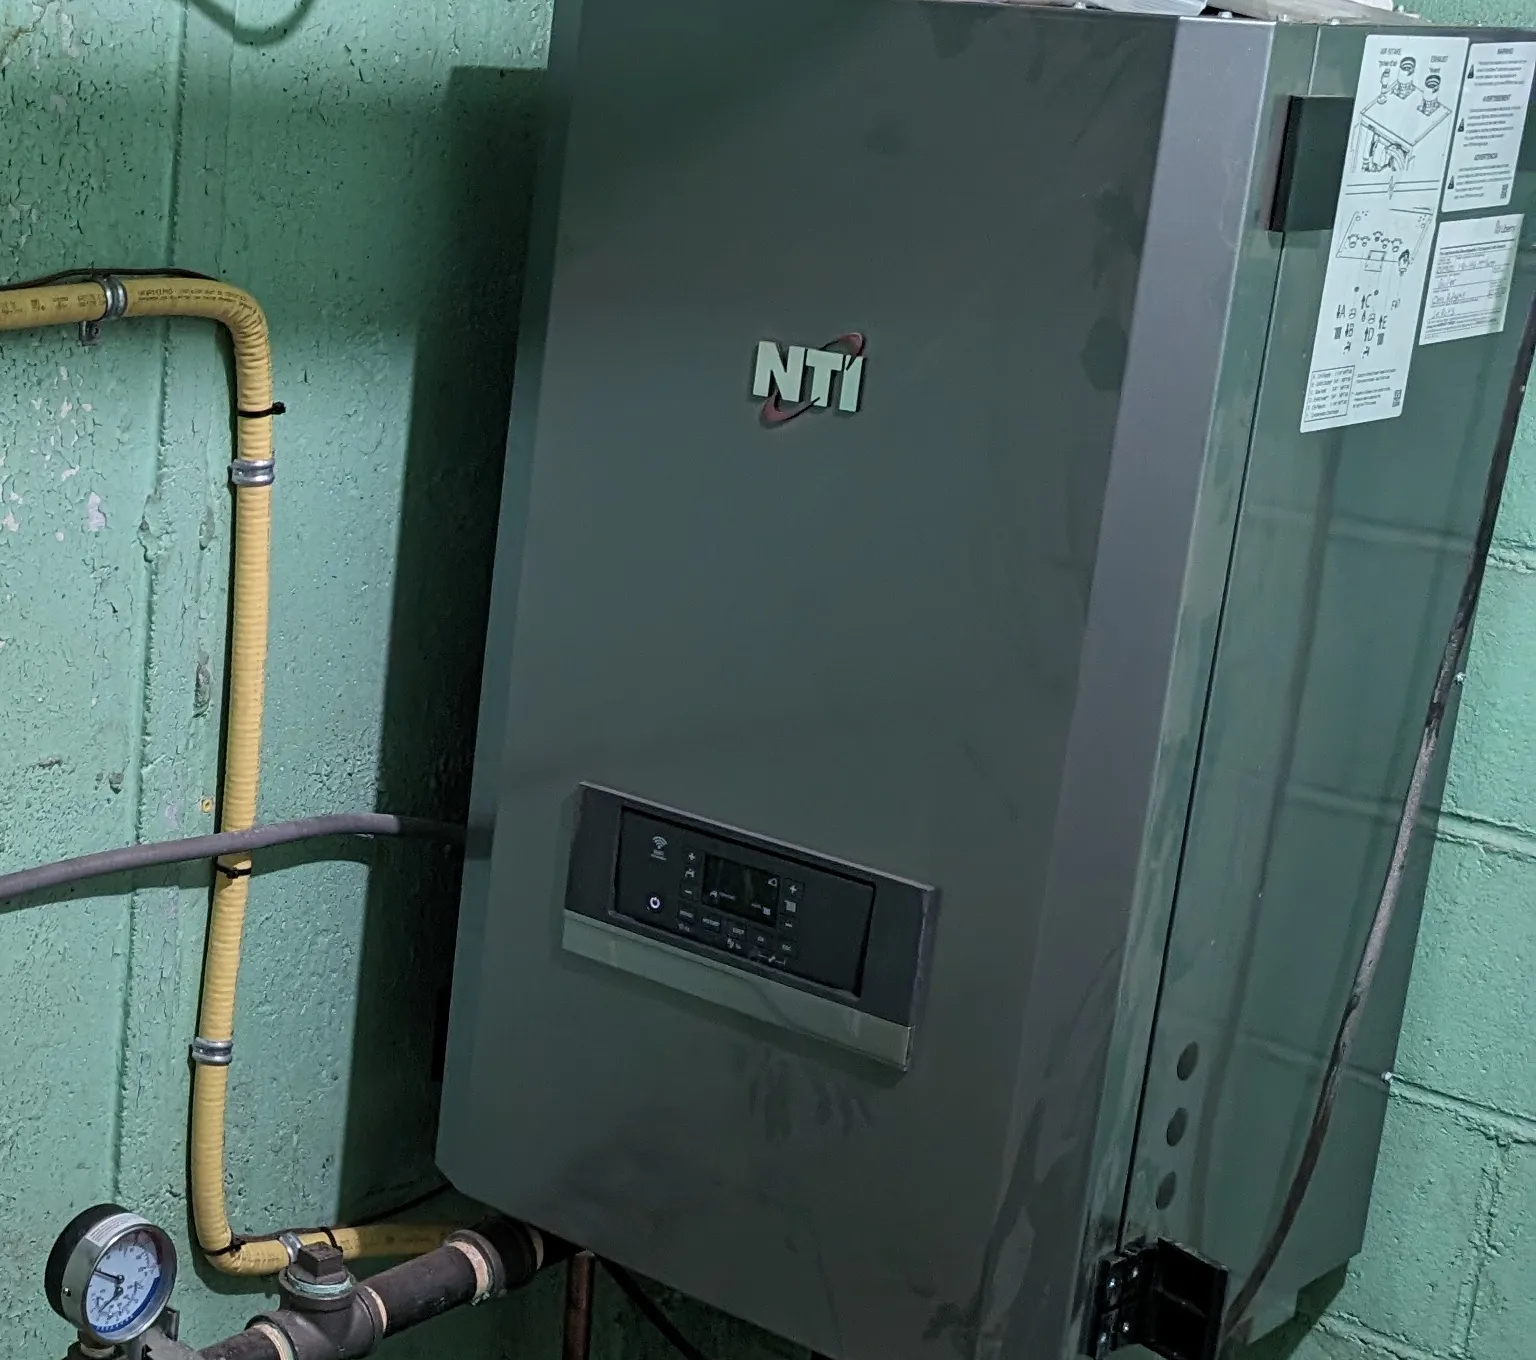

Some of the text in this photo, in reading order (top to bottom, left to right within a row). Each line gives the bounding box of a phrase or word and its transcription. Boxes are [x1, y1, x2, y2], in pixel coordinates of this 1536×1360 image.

[1340, 304, 1346, 319] A
[1382, 315, 1388, 330] E
[1367, 327, 1374, 342] D
[753, 340, 866, 413] NTI
